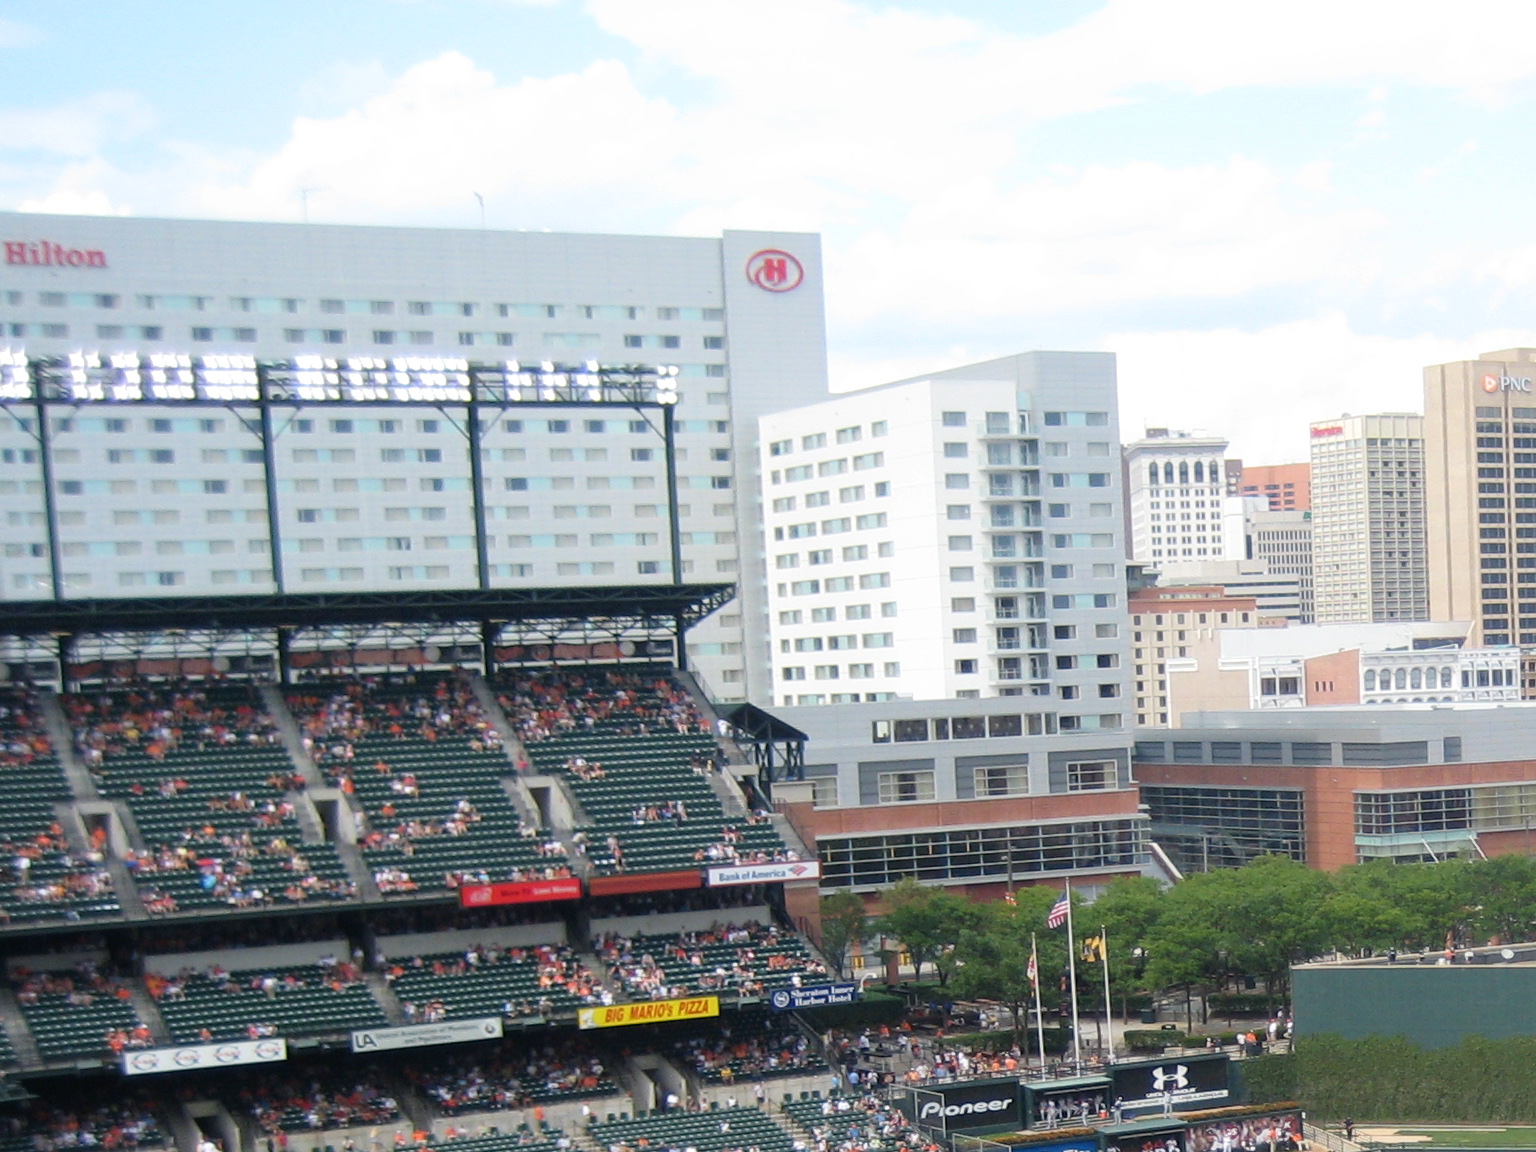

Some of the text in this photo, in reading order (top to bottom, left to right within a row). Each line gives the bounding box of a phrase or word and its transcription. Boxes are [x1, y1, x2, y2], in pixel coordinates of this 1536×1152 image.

[3, 240, 108, 267] Hilton
[1500, 376, 1531, 392] PNC
[719, 870, 786, 882] Bank of America
[791, 989, 828, 998] Sheraton
[795, 993, 851, 1006] Harbor Hotel
[605, 1000, 709, 1022] BIG MARIO's PIZZA
[921, 1099, 1012, 1119] Pioneer
